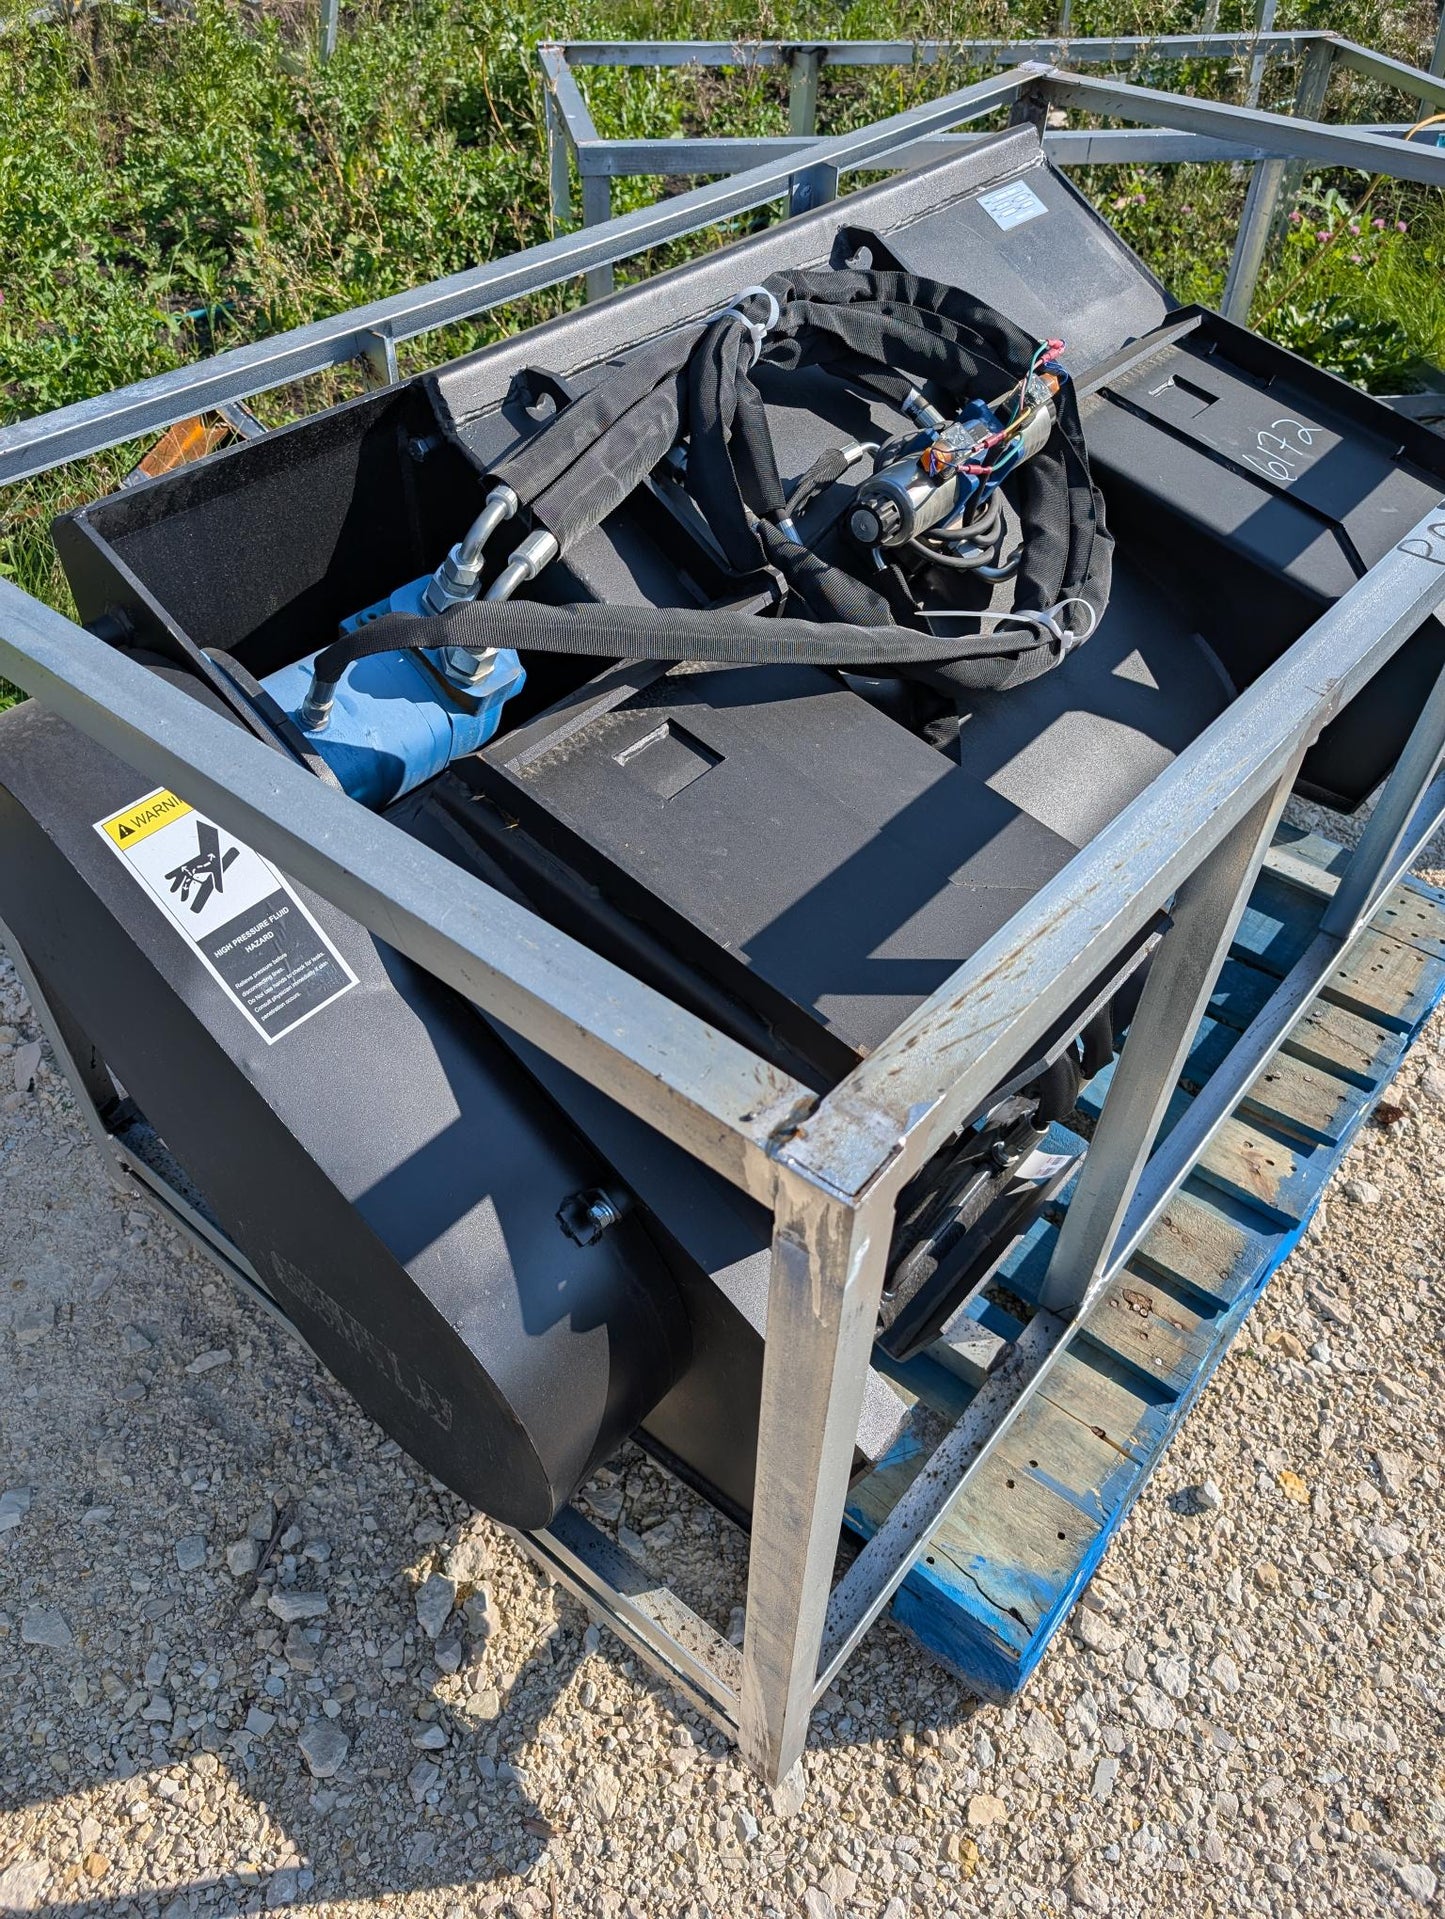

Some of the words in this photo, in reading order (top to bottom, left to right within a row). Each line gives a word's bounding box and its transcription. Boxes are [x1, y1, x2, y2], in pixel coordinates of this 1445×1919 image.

[1241, 419, 1323, 482] 6172
[130, 796, 182, 828] WARNI
[213, 943, 233, 958] HIGH
[231, 919, 270, 946] PRESSURE
[268, 906, 290, 923] FLUID
[244, 931, 274, 953] HAZARD
[234, 975, 254, 989] Relieve
[252, 963, 273, 978] pressure
[271, 953, 287, 964] before
[241, 975, 273, 997] disconnecting
[271, 967, 285, 977] lines.
[254, 991, 264, 1000] Not
[263, 986, 273, 994] use
[271, 977, 287, 988] hands
[291, 964, 305, 975] check
[304, 959, 312, 967] for
[310, 952, 325, 962] leaks.
[254, 998, 272, 1013] Consult
[271, 985, 292, 1002] physician
[260, 1002, 286, 1021] penetration
[284, 992, 302, 1005] occurs.
